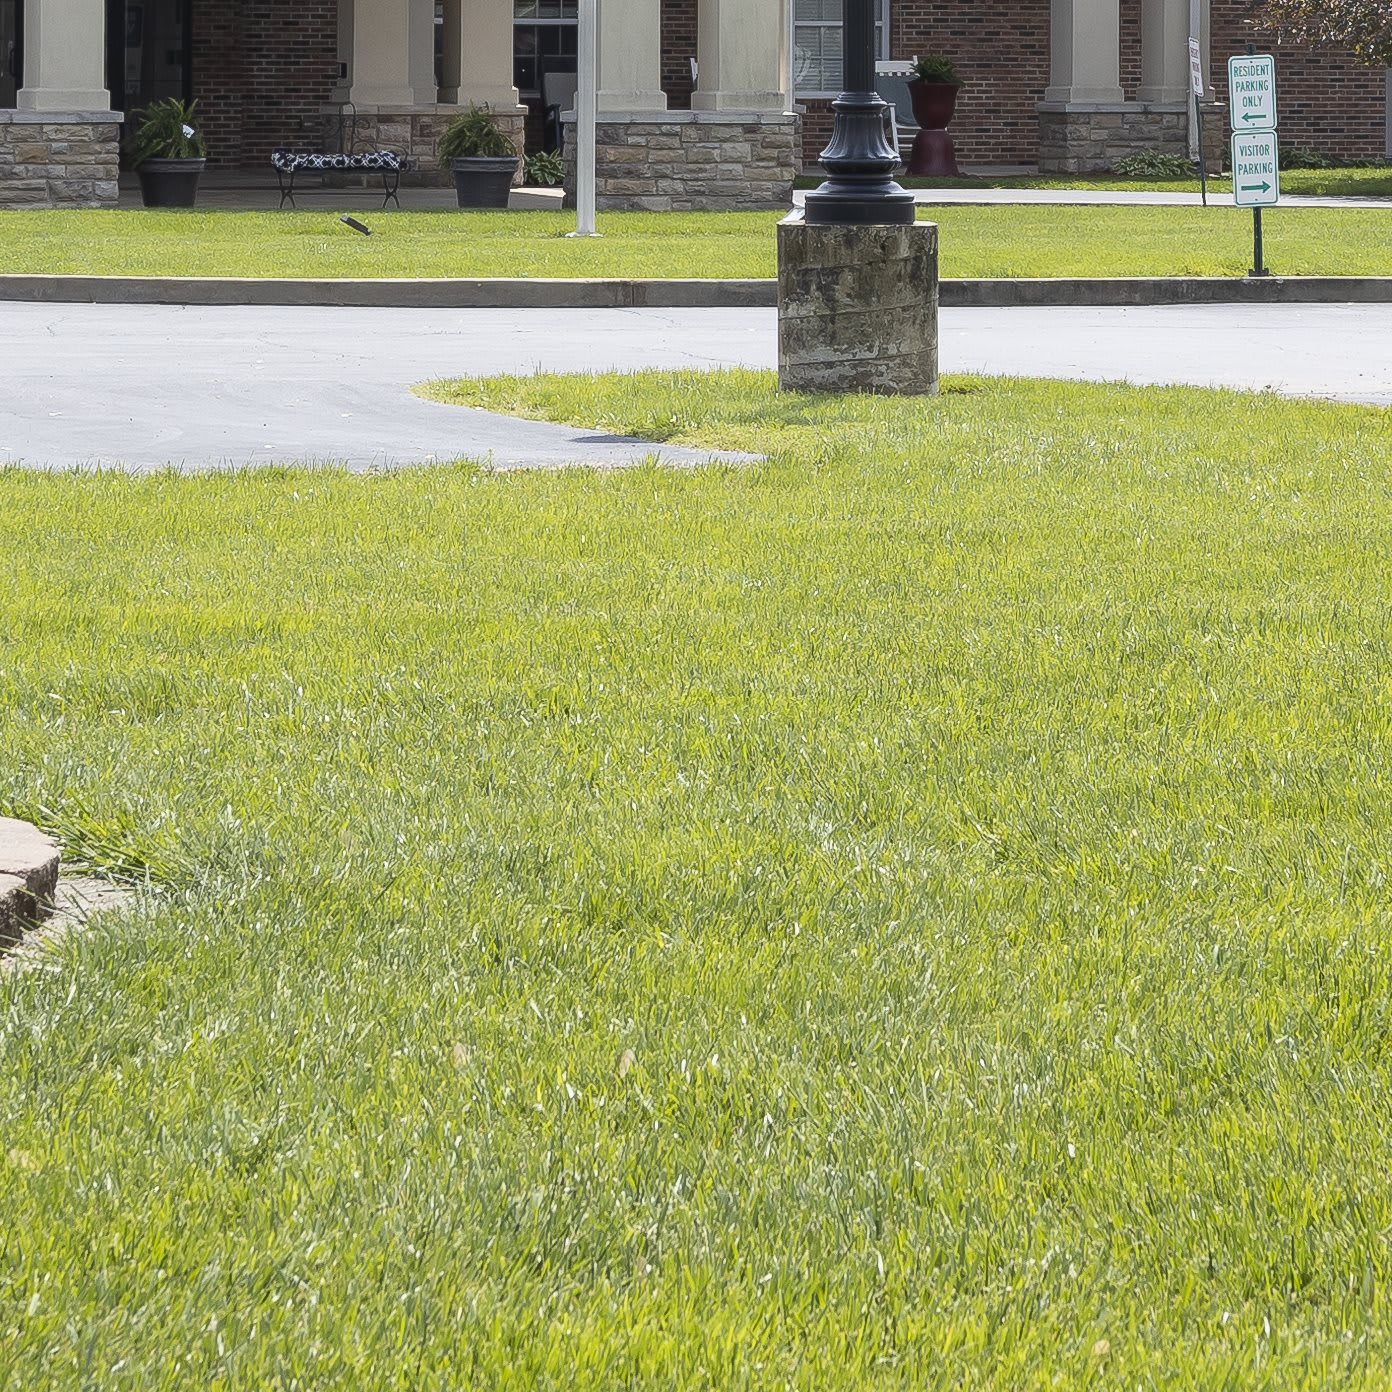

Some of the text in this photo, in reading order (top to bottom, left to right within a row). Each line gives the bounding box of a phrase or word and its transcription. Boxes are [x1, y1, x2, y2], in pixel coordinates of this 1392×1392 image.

[1233, 64, 1270, 78] RESIDENT
[1235, 80, 1269, 93] PARKING
[1242, 95, 1264, 108] ONLY
[1239, 144, 1270, 157] VISITOR
[1237, 162, 1273, 175] PARKING
